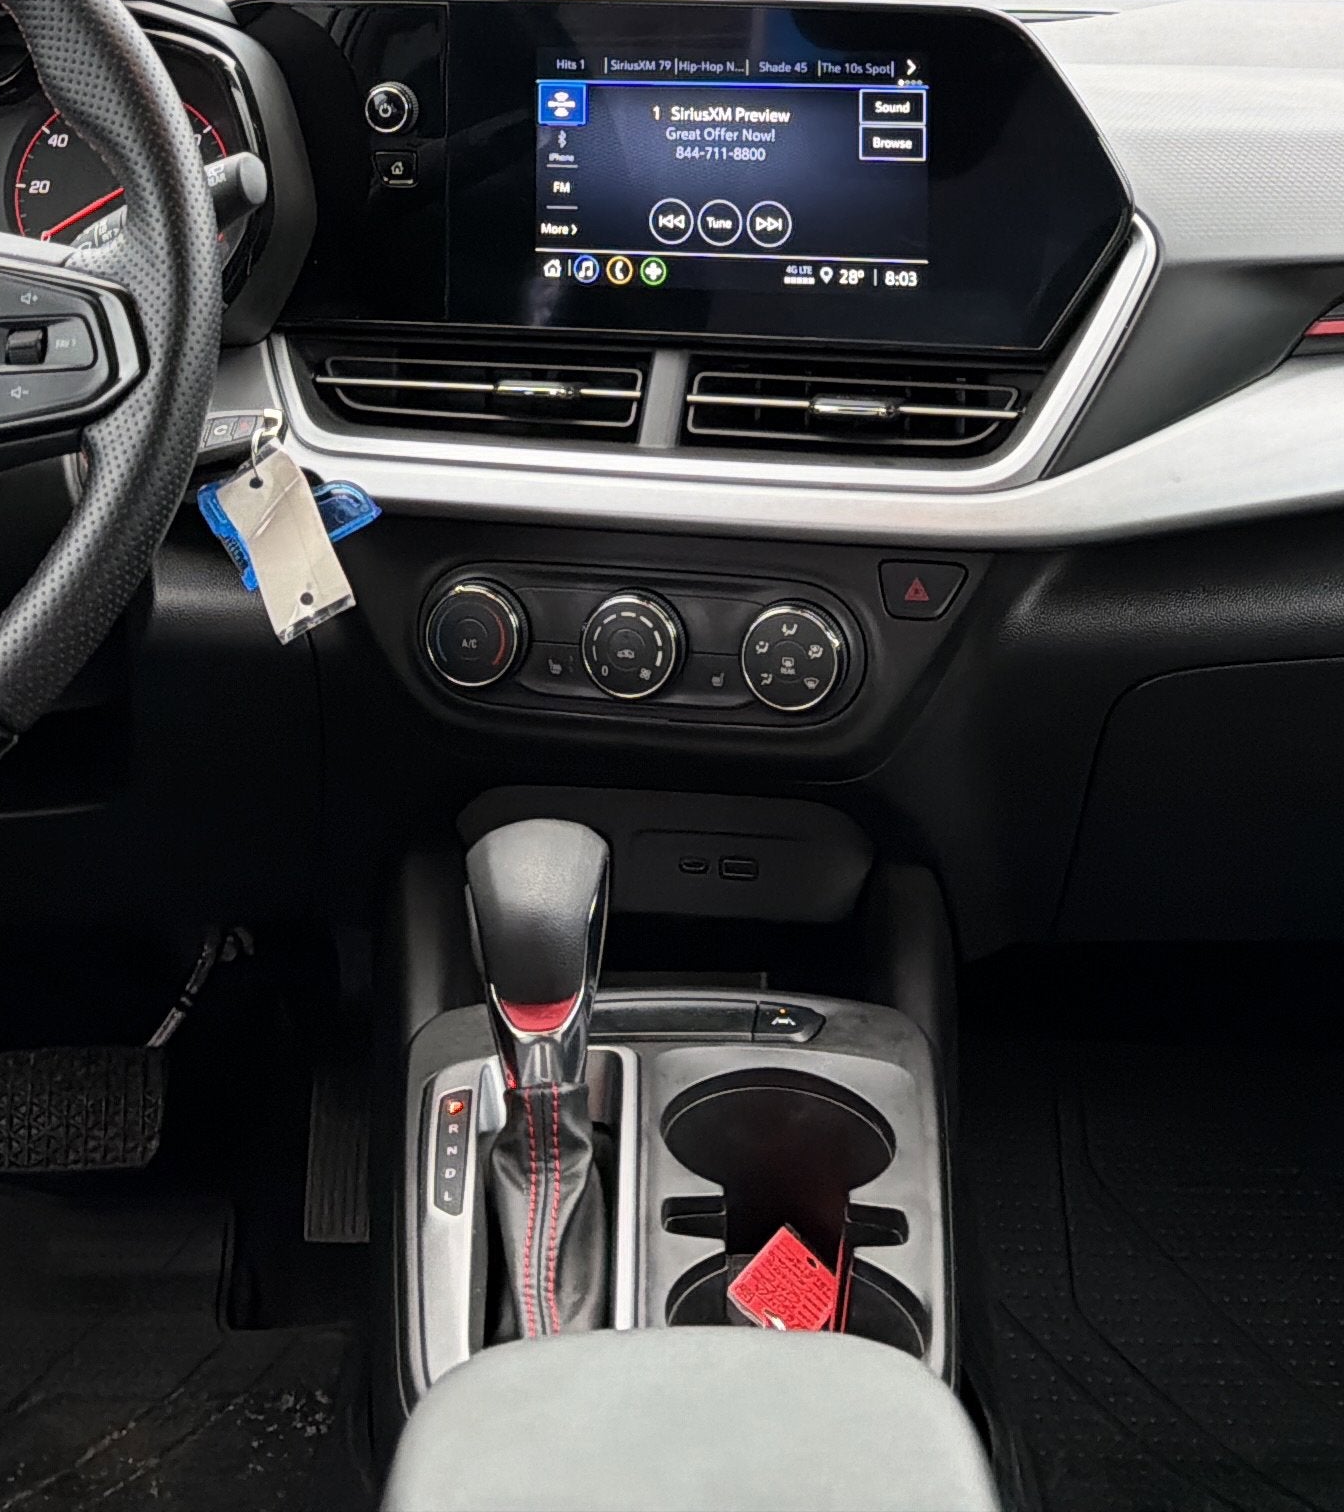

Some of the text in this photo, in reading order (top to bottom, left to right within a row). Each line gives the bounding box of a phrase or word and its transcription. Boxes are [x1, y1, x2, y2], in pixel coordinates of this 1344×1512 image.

[557, 59, 585, 70] Hits 1
[610, 60, 671, 71] SiriusXM 79
[678, 61, 723, 74] Hip-Hop
[759, 61, 808, 73] Shade 45
[822, 62, 891, 76] The 10s Spot
[874, 100, 911, 114] Sound
[653, 105, 791, 124] 1 SiriusXM Preview
[47, 133, 69, 148] 40
[665, 127, 776, 143] Great Offer Now!
[872, 136, 913, 150] Browse
[675, 146, 766, 162] 844-711-8800
[28, 180, 51, 194] 20
[553, 181, 571, 194] FM
[540, 222, 569, 235] More
[706, 216, 733, 229] Tune
[786, 265, 813, 275] 4G LTE
[884, 271, 918, 287] 8:03
[461, 638, 478, 650] A/C
[449, 1100, 464, 1115] P
[448, 1123, 459, 1134] R
[446, 1145, 458, 1156] N
[444, 1168, 456, 1179] D
[443, 1190, 453, 1202] L
